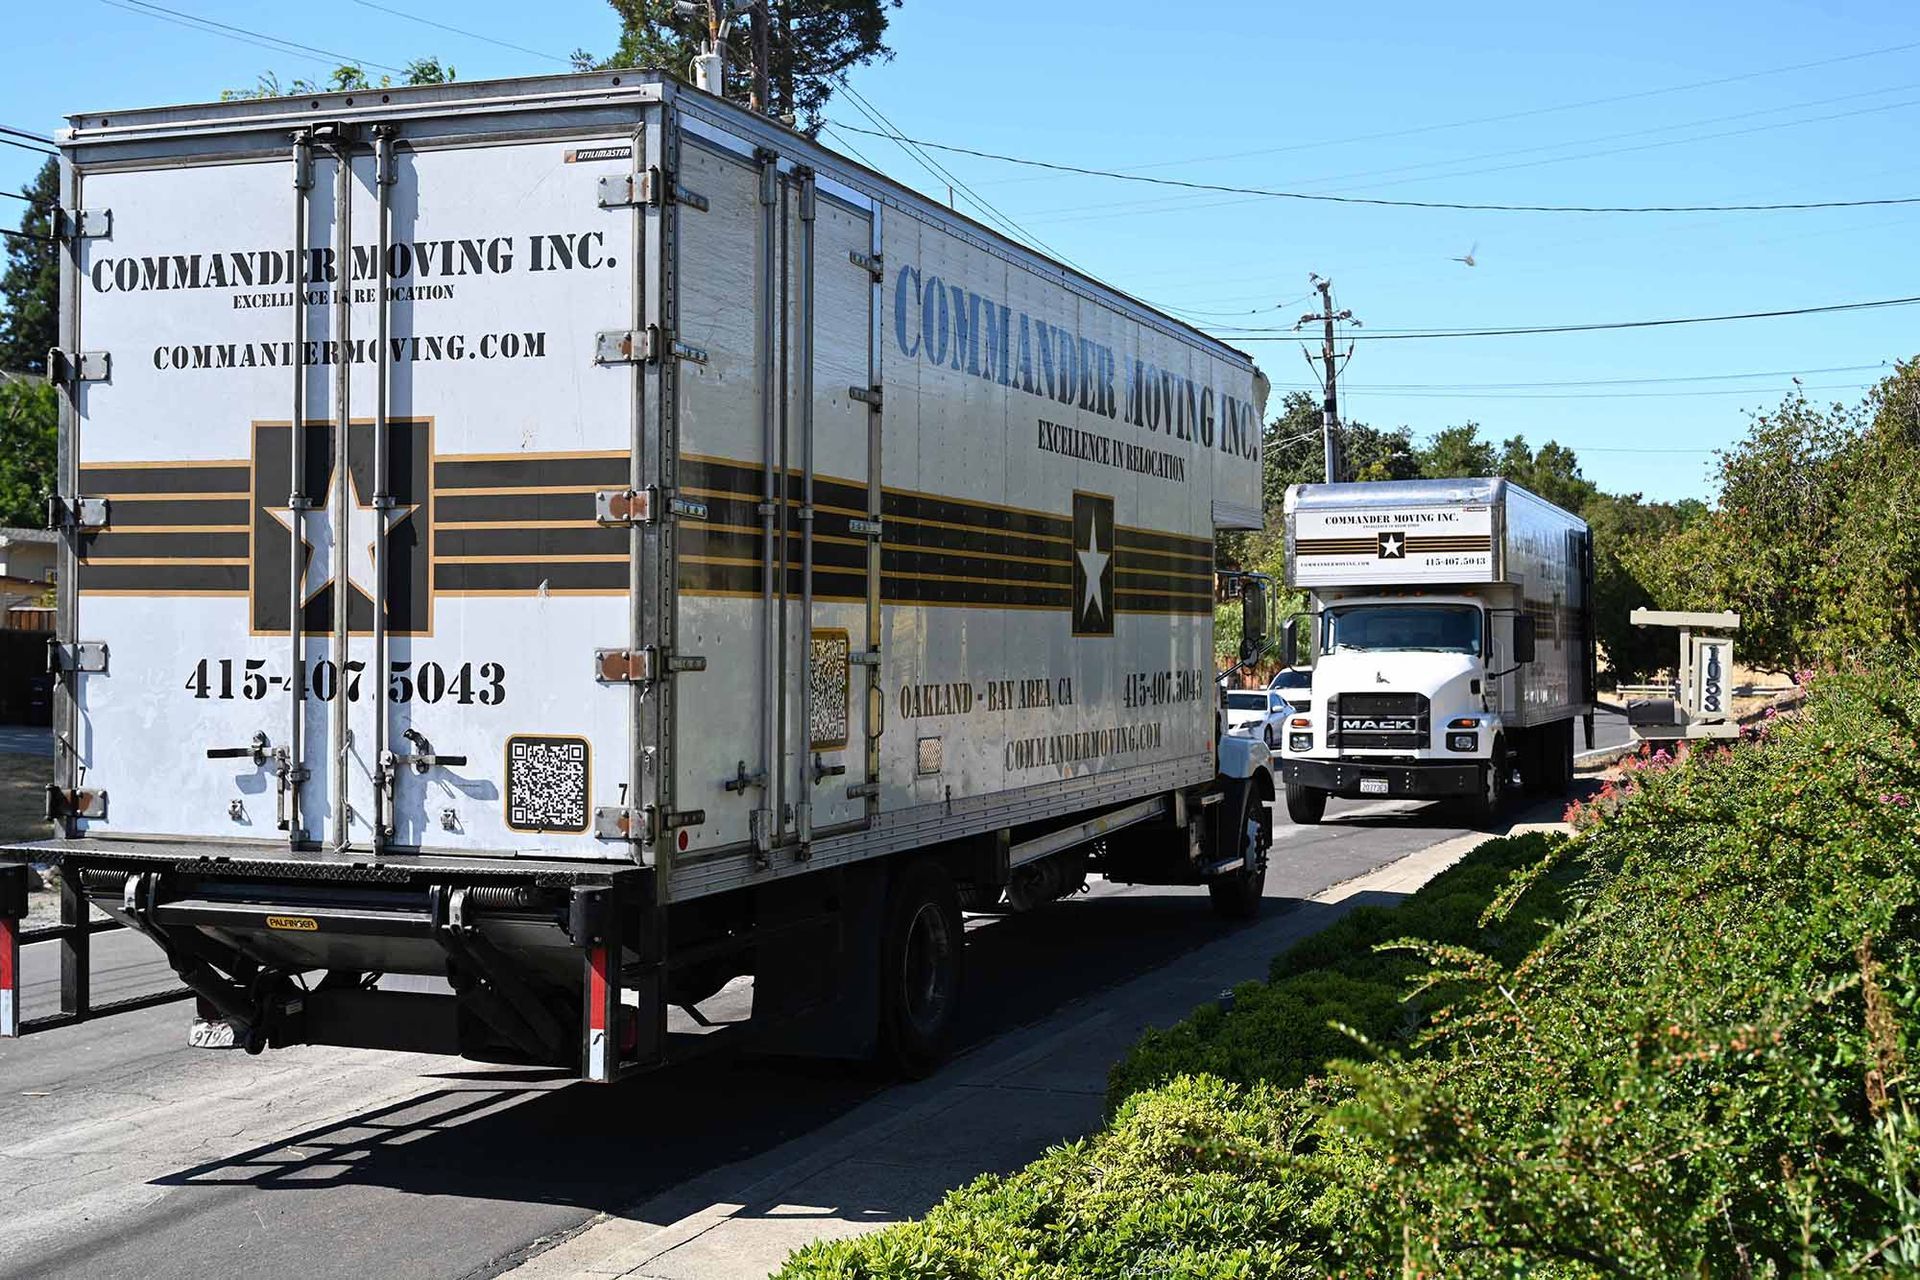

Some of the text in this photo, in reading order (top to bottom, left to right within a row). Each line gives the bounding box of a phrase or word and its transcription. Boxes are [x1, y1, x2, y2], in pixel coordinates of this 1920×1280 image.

[577, 148, 630, 159] UTILIMASTER
[91, 231, 617, 293] COMMANDER MOVING INC.
[354, 284, 455, 303] REOCATION
[895, 264, 1259, 463] COMMANDER MOVING INC.
[1037, 418, 1185, 483] EXCELLENCE IN RELOCATION
[1325, 511, 1460, 526] COMMANDER MOVING INC.
[899, 682, 973, 720] OAKLAND
[988, 680, 1015, 712] BAY
[1018, 677, 1056, 711] AREA,
[1058, 676, 1074, 705] CA
[1123, 670, 1203, 708] 415-407.5043
[1343, 720, 1412, 729] MACK
[1005, 721, 1162, 773] COMMANDERMOVING.COM
[79, 766, 86, 787] 7
[618, 783, 628, 806] 7
